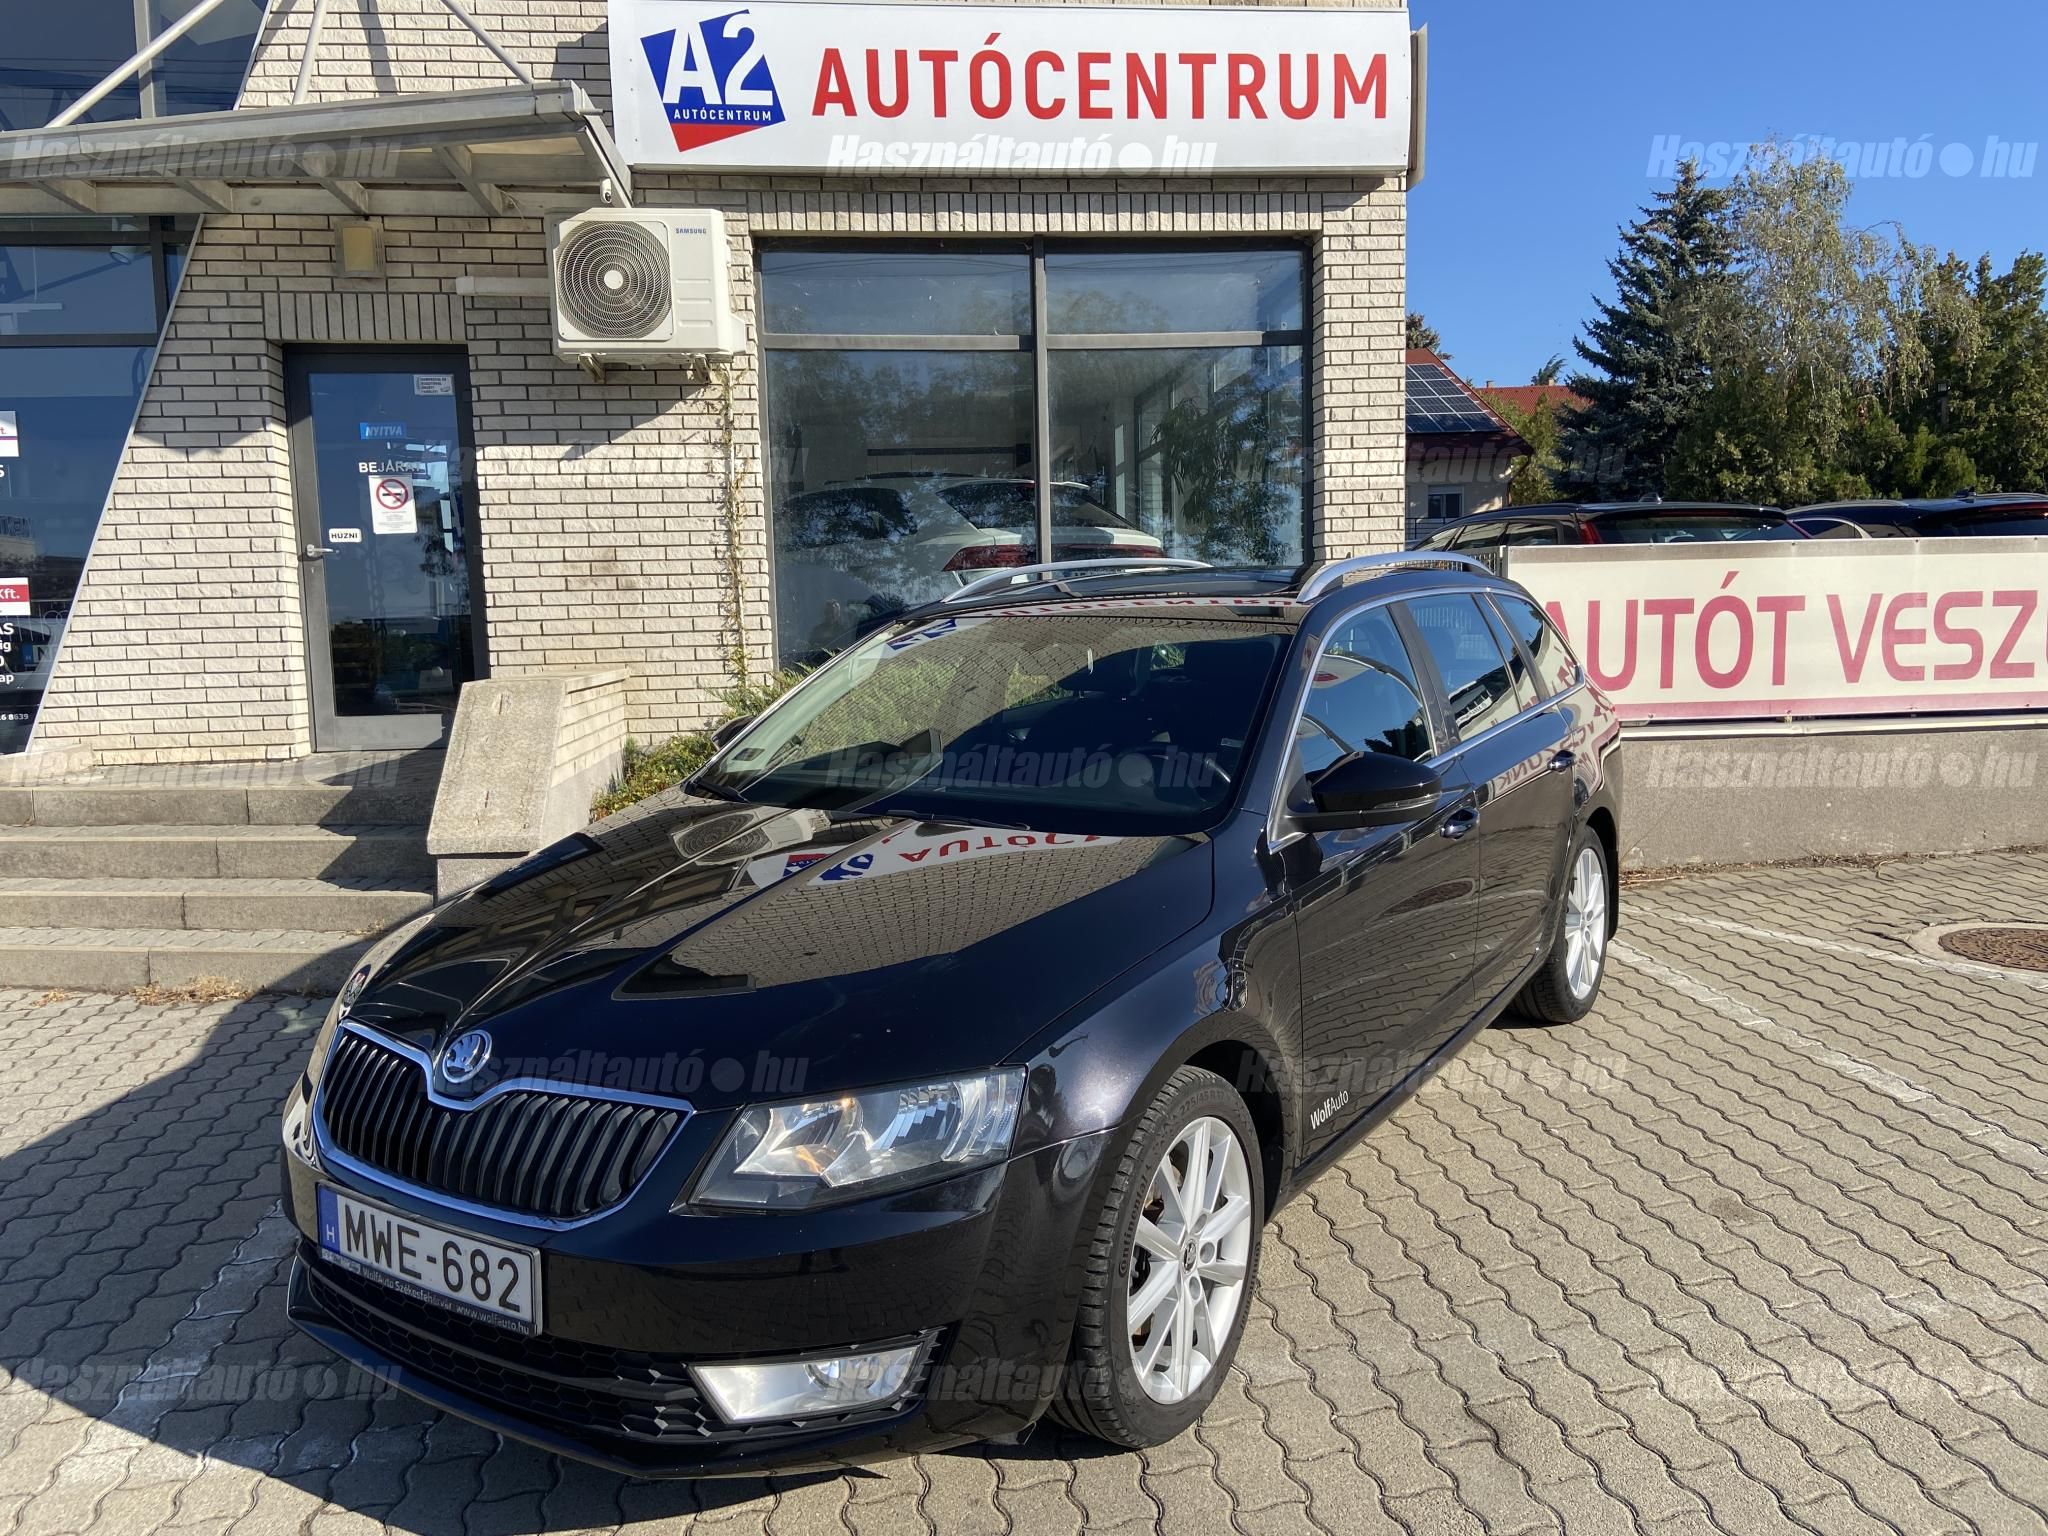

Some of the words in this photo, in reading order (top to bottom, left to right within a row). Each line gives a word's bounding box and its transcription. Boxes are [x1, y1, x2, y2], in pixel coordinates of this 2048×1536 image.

[662, 13, 773, 106] A2
[812, 32, 1387, 120] AUTÓCENTRUM
[674, 107, 771, 121] AUTÓCENTRUM
[366, 426, 402, 437] NYITVA
[1827, 590, 2048, 684] VESZ
[1310, 1090, 1349, 1130] WolfAuto
[325, 1224, 335, 1243] H
[345, 1204, 520, 1313] MWE-682
[362, 1266, 394, 1289] WolfAuto
[456, 1305, 530, 1335] www.wolfauto.hu
